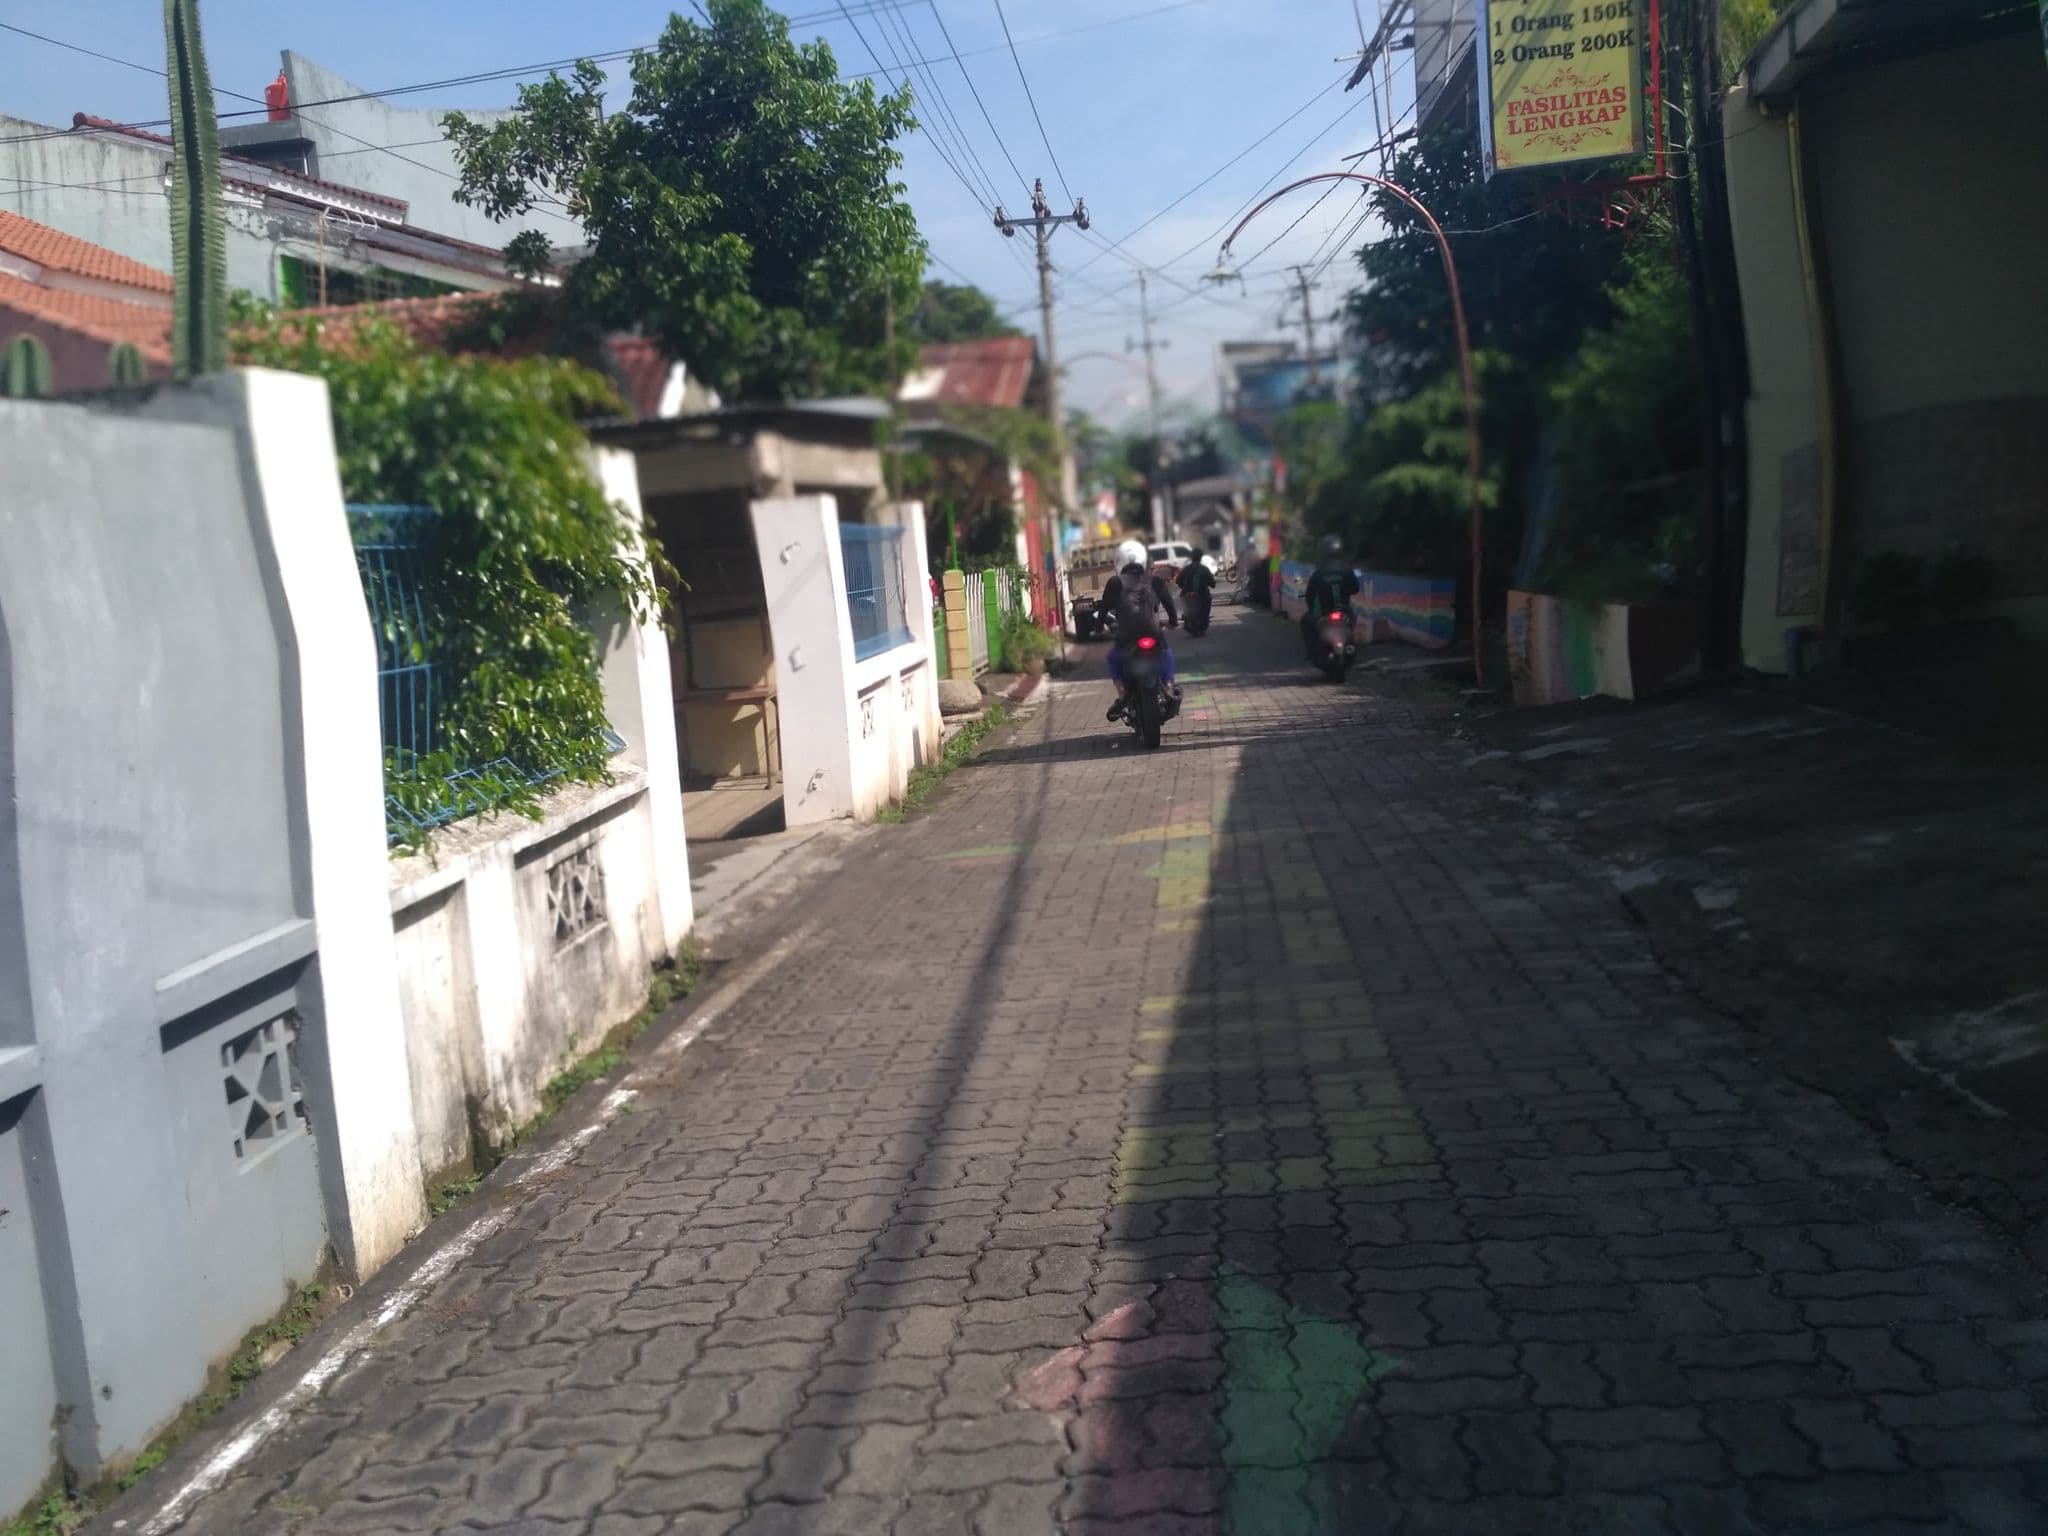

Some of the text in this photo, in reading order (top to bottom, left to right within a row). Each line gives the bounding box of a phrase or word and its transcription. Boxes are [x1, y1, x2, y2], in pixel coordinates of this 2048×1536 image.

[1495, 1, 1634, 36] 1 Orang 150K
[1494, 30, 1635, 65] 2 Orang 200K
[1507, 86, 1627, 117] FASILITAS
[1508, 105, 1627, 135] LENGKAP
